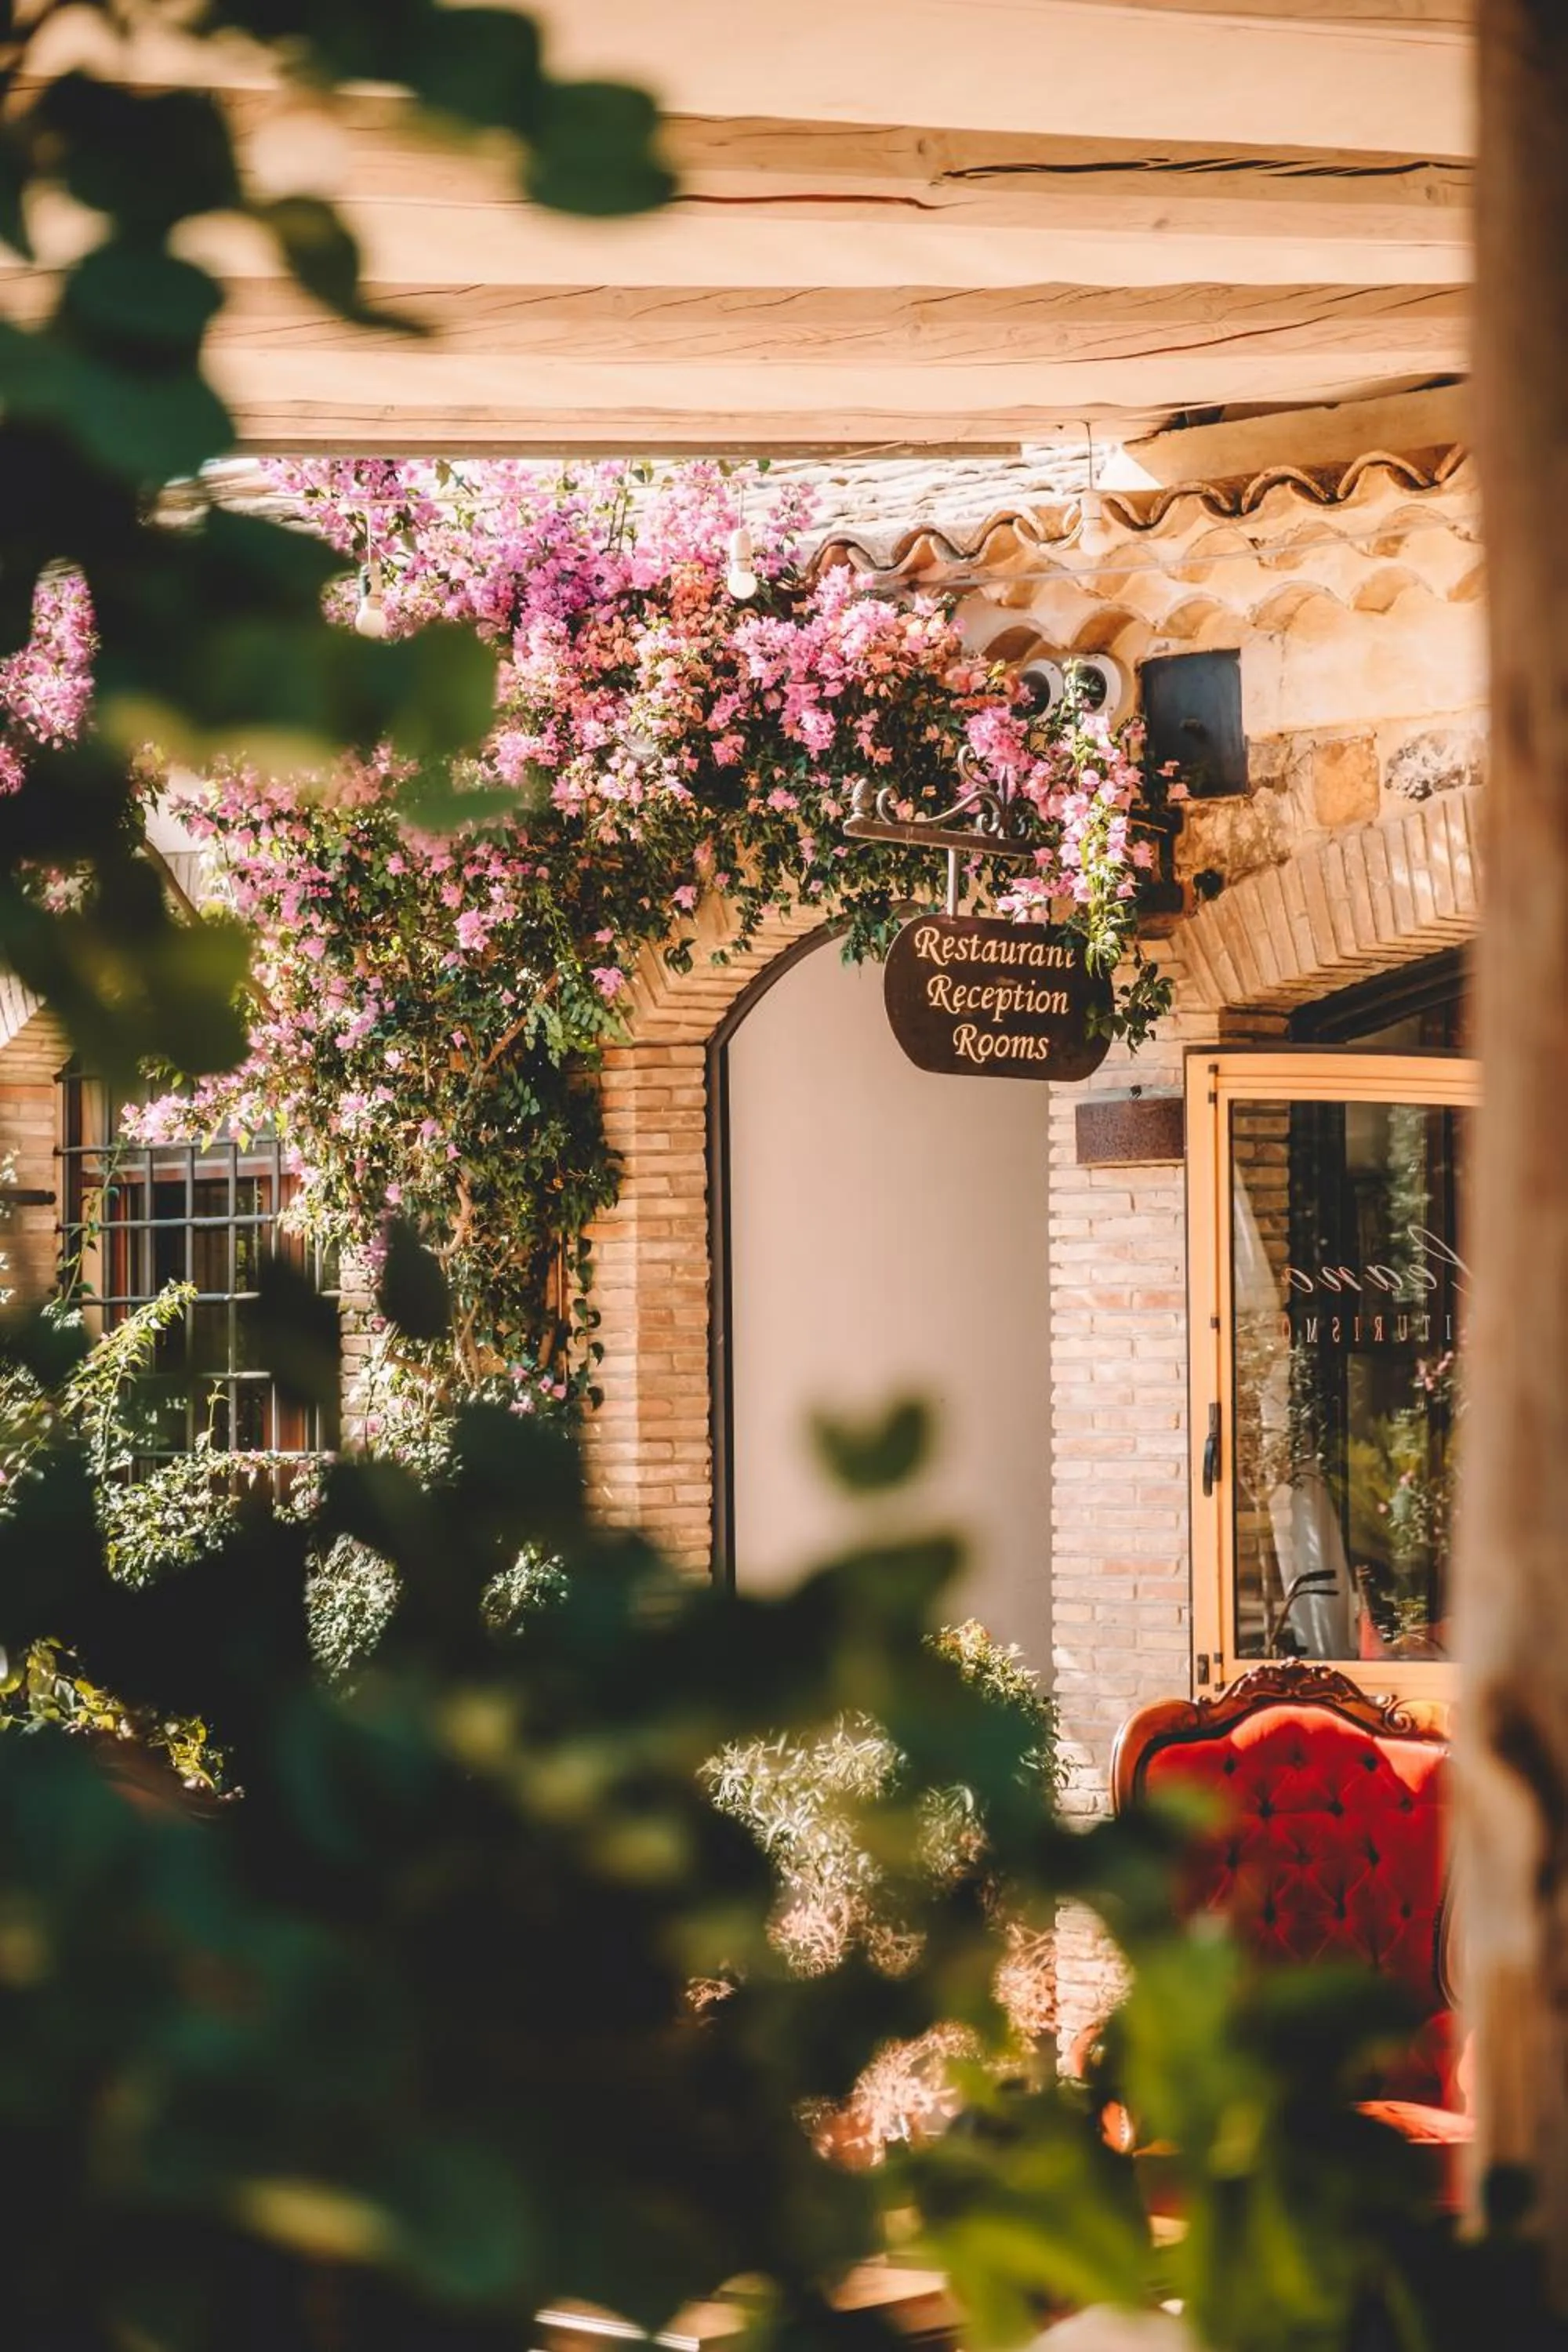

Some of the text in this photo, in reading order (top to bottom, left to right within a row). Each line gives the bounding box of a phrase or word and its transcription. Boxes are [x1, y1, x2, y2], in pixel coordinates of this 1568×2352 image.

[915, 926, 1076, 968] Restaurant
[927, 975, 1069, 1022] Reception
[953, 1023, 1049, 1063] Rooms
